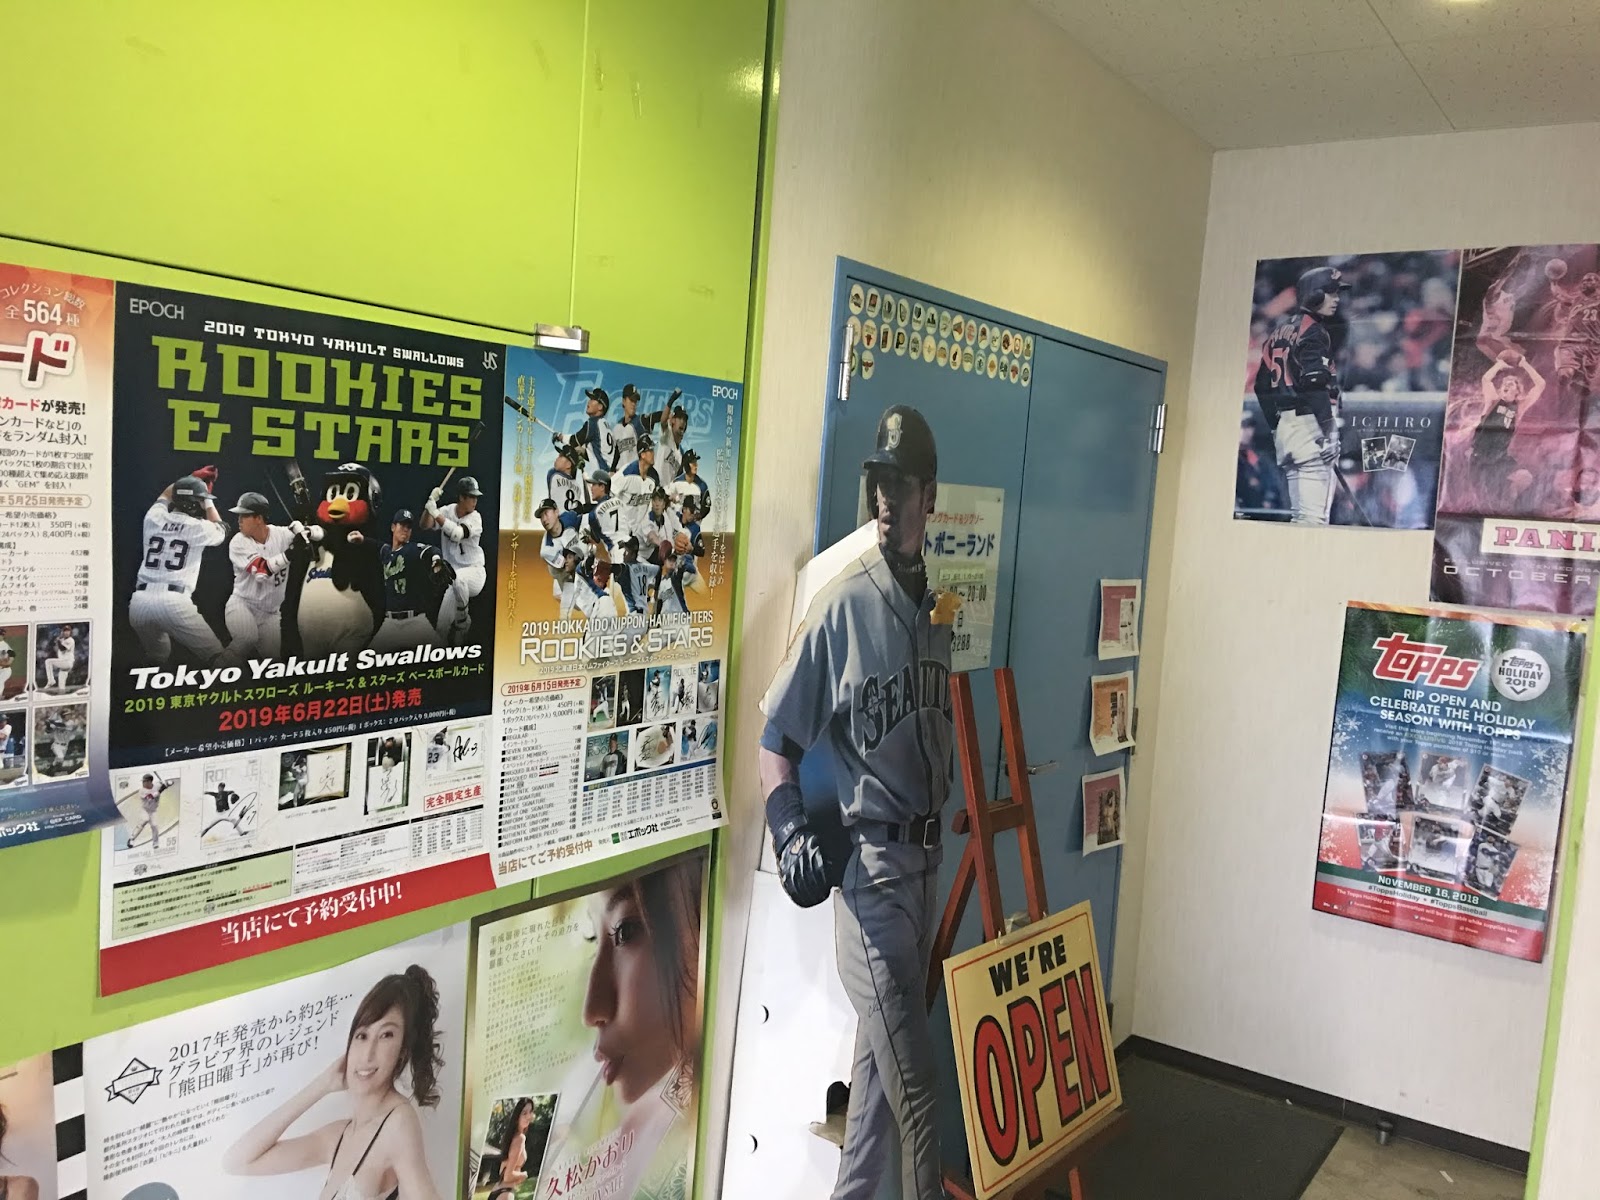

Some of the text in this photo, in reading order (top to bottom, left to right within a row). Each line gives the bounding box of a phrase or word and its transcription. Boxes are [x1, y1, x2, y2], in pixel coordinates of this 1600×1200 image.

[130, 298, 185, 320] EPOCH
[204, 320, 464, 368] 2019 TOKYO YAKULT SWALLOWS
[152, 335, 482, 420] ROOKIES
[712, 384, 739, 400] EPOCH
[0, 396, 86, 415] カードが発売!
[1351, 415, 1431, 428] ICHIRO
[252, 406, 469, 468] STARS
[144, 535, 190, 572] 23
[1494, 526, 1600, 553] PANI
[1443, 565, 1592, 586] OCTOBER
[522, 622, 549, 637] 2019
[552, 617, 608, 635] HOKKAIDO
[672, 610, 714, 627] FIGHTERS
[520, 627, 714, 665] ROOKIES & STARS
[129, 644, 482, 690] Tokyo Yakult Swallows
[1498, 667, 1543, 680] HOLIDAY
[1505, 677, 1536, 688] 2018
[124, 663, 485, 713] 2019 東京ヤクルトスワローズ ルーキーズ & スターズ ベースボールカード
[1404, 688, 1502, 712] RIP OPEN AND
[218, 687, 423, 732] 2019年6月22日(土)発売
[1370, 696, 1536, 730] CELEBRATE THE HOLIDAY
[1380, 709, 1521, 742] SEASON WITH TOPPS
[426, 785, 482, 808] 完全限定生産
[1368, 884, 1489, 918] #ToppsHoliday #ToppsBaseball
[1378, 875, 1480, 905] NOVEMBER 16, 2018
[221, 881, 403, 946] 当店にて予約受付中!
[988, 934, 1067, 997] WE'RE
[169, 1010, 340, 1082] グラビア界のレジェンド
[973, 961, 1112, 1167] OPEN
[546, 1129, 635, 1200] 久松かおり
